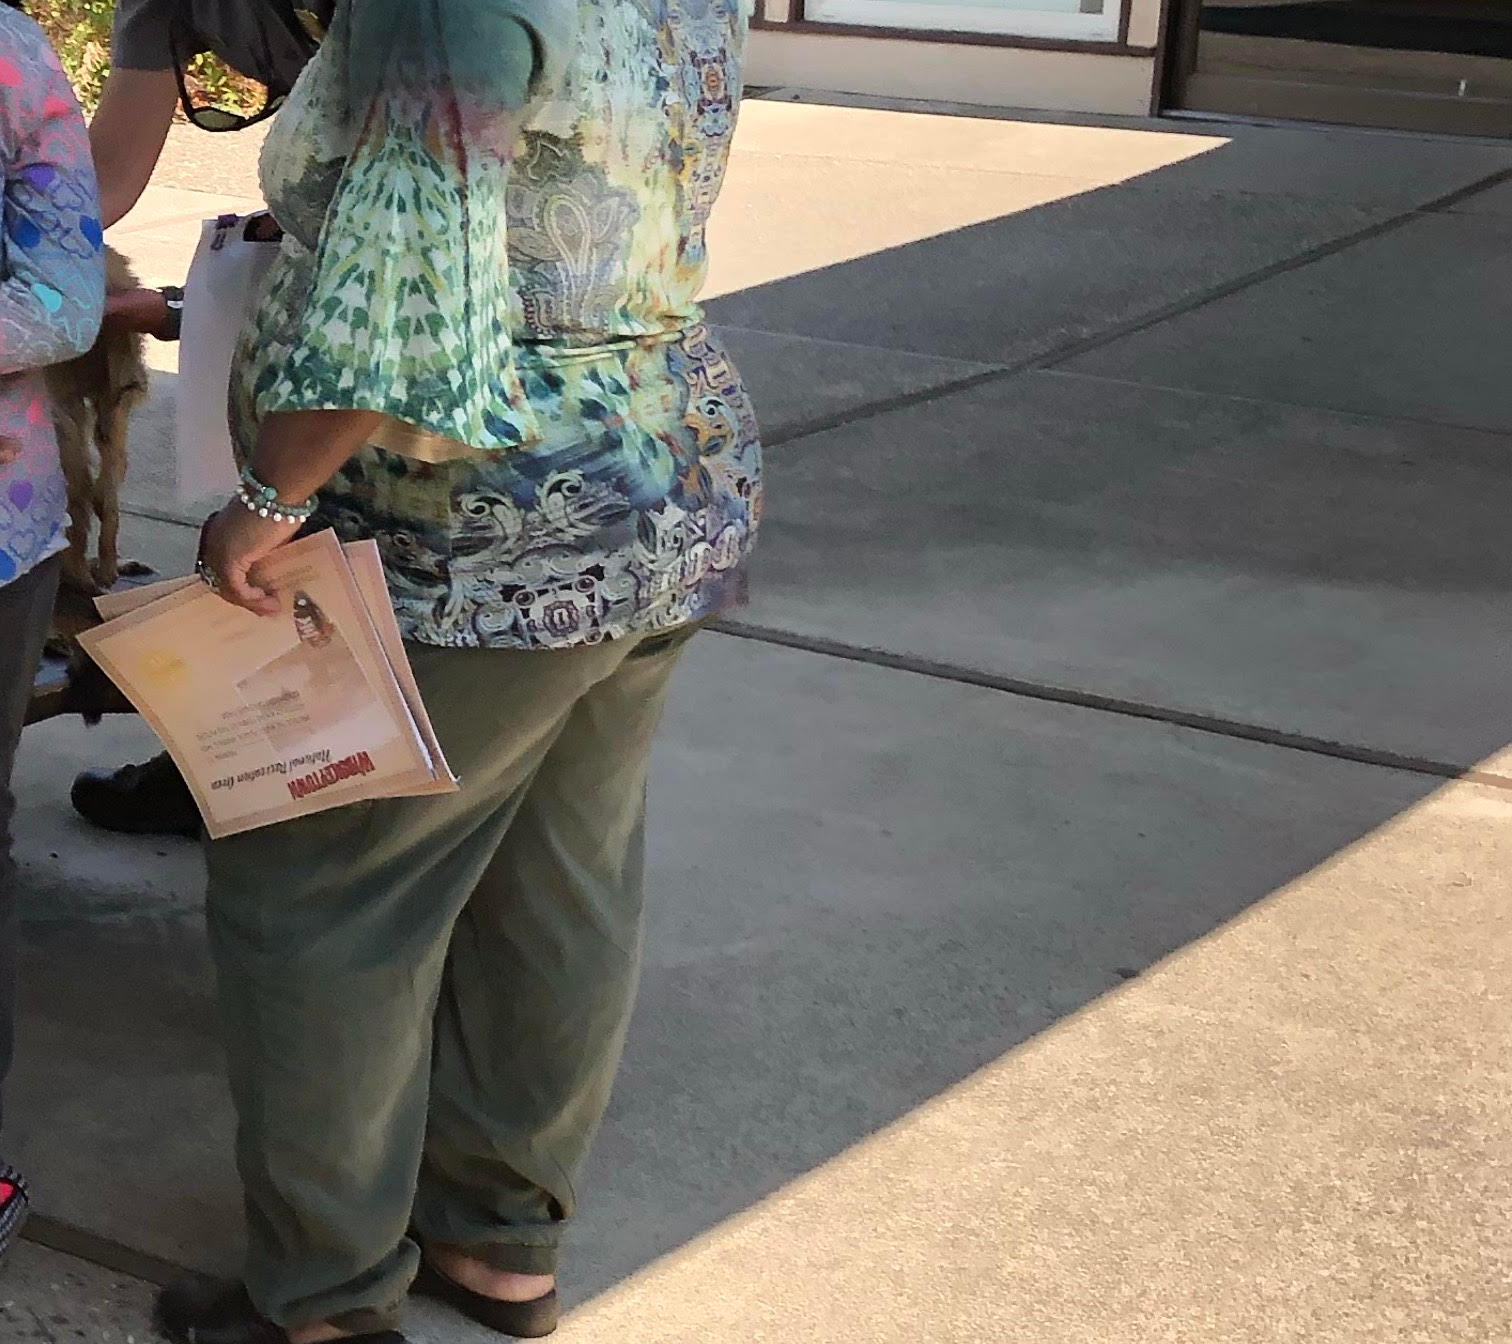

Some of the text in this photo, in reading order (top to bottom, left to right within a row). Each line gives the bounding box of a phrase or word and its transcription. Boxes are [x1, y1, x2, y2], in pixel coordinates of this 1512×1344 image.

[211, 749, 331, 790] National Recreation Area
